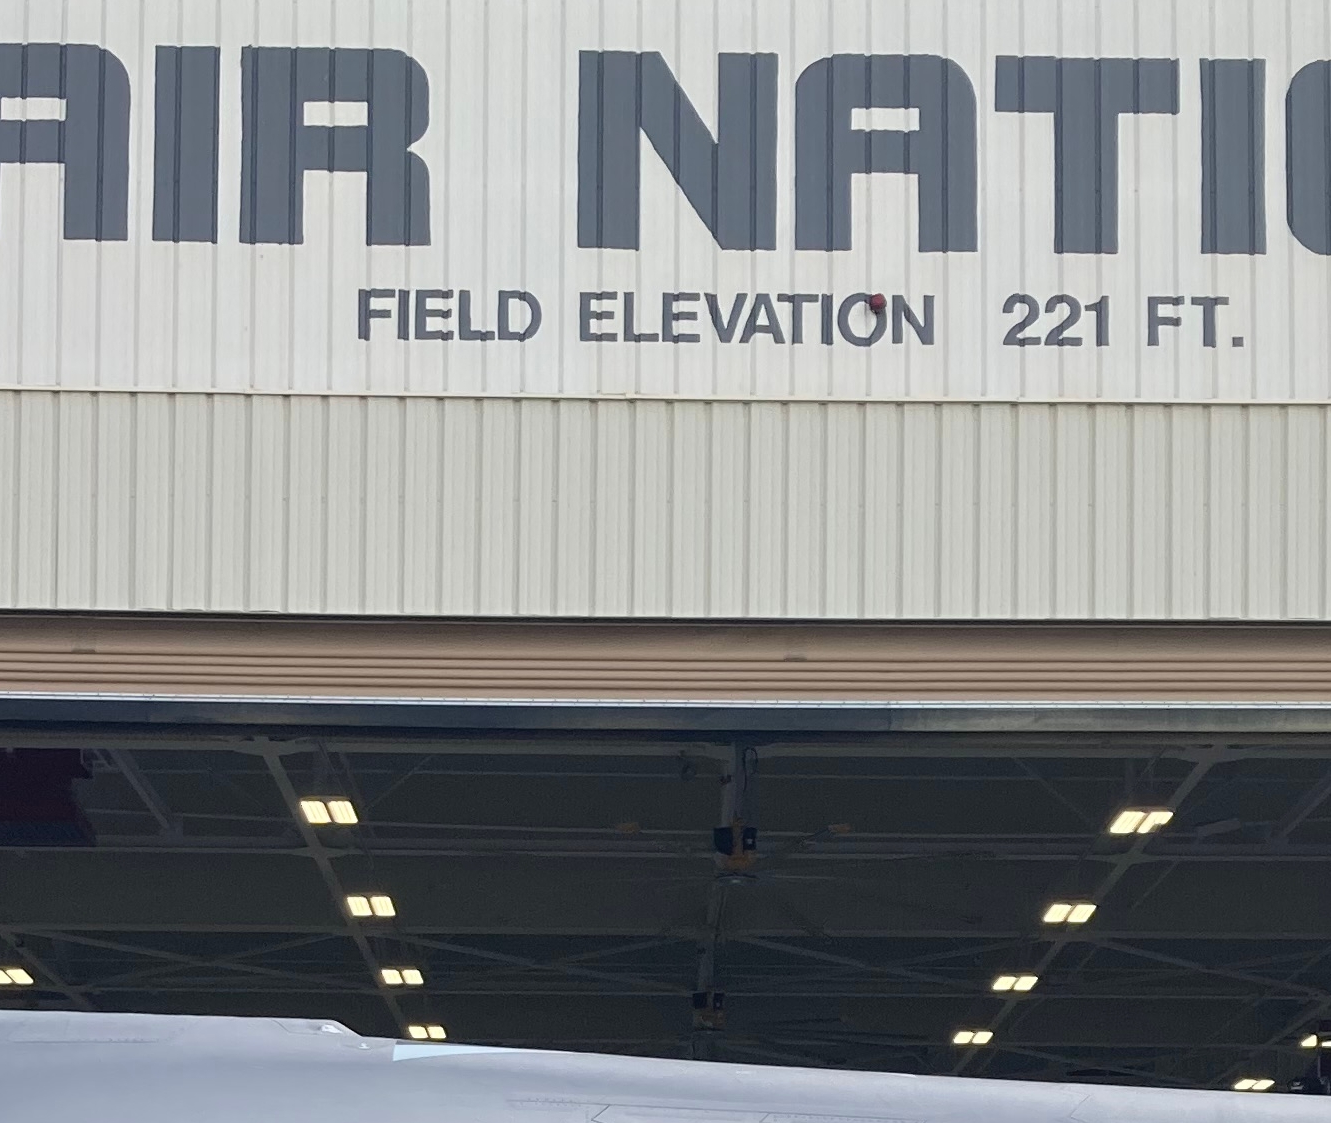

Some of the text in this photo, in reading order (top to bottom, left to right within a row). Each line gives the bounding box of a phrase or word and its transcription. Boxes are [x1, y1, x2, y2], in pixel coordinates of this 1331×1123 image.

[358, 289, 1245, 348] FIELD ELEVATION 221 FT.
